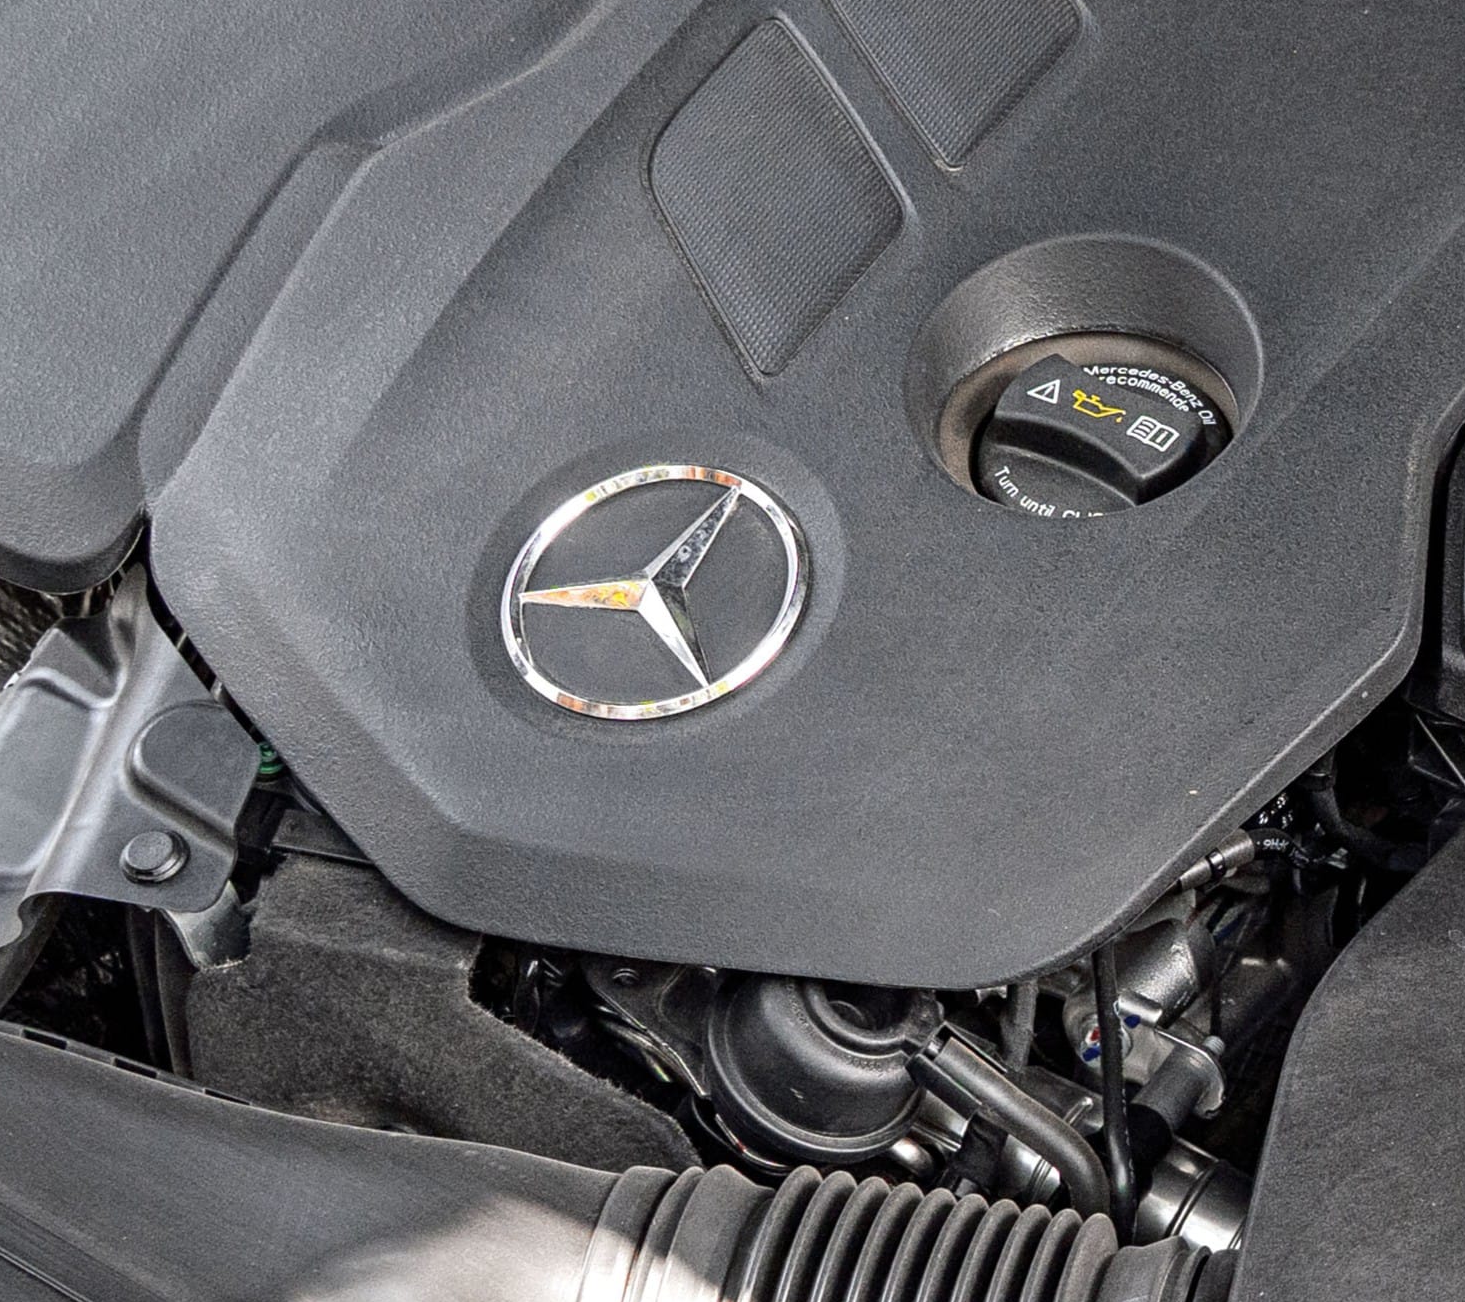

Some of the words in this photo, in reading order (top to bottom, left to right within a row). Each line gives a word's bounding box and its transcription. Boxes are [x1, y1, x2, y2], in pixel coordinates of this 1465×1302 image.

[1083, 365, 1203, 408] Mercedes-Benz
[1198, 410, 1217, 425] Oil
[1099, 375, 1190, 412] ecommende
[994, 466, 1019, 497] Turn
[1020, 496, 1055, 517] until
